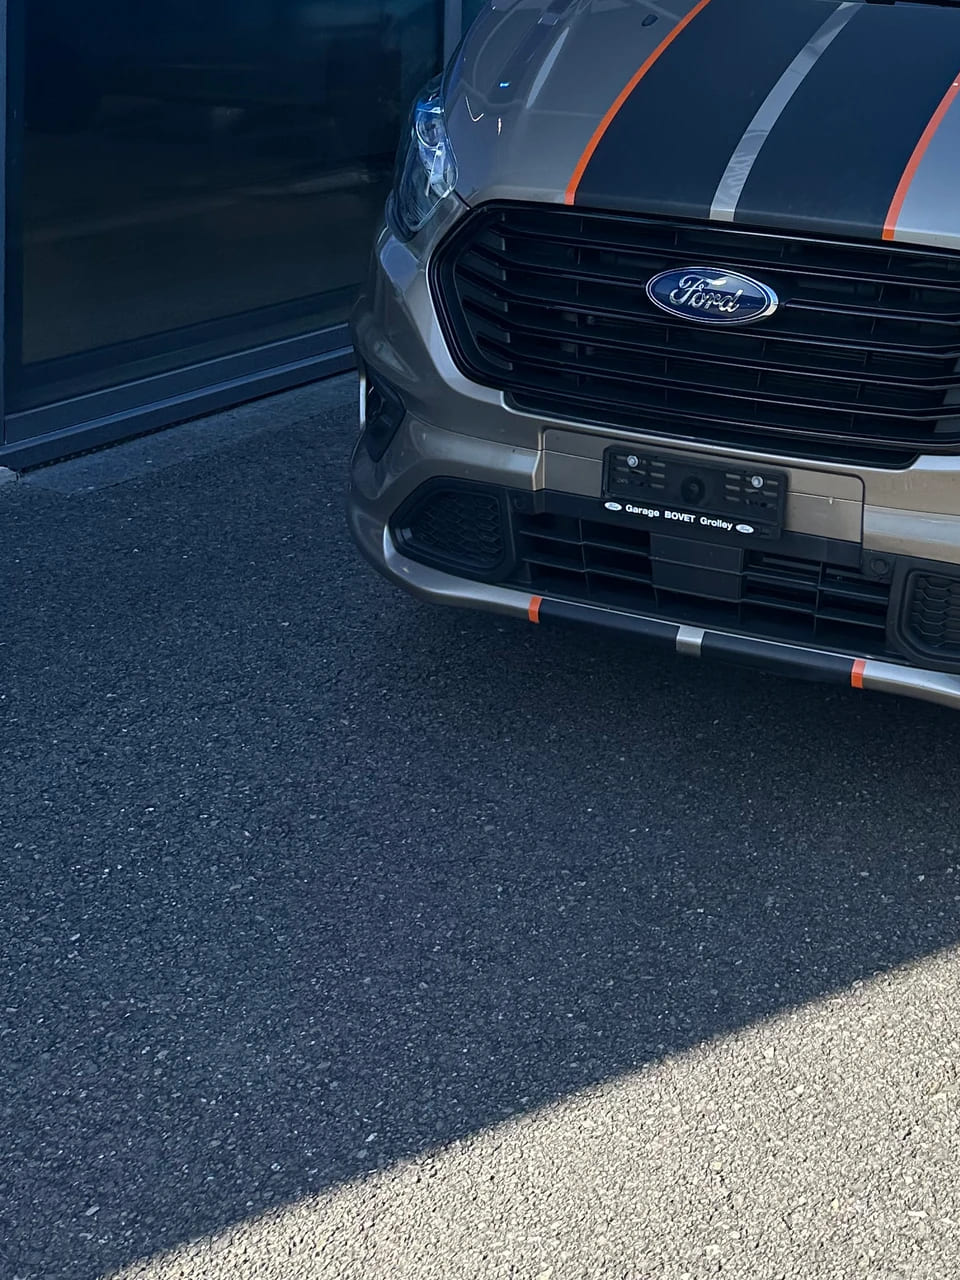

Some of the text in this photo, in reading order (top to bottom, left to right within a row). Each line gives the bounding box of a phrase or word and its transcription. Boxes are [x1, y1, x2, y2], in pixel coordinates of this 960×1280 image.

[669, 274, 743, 312] Ford
[625, 504, 660, 518] Garage
[664, 510, 696, 523] BOVET
[700, 517, 733, 531] Grolley
